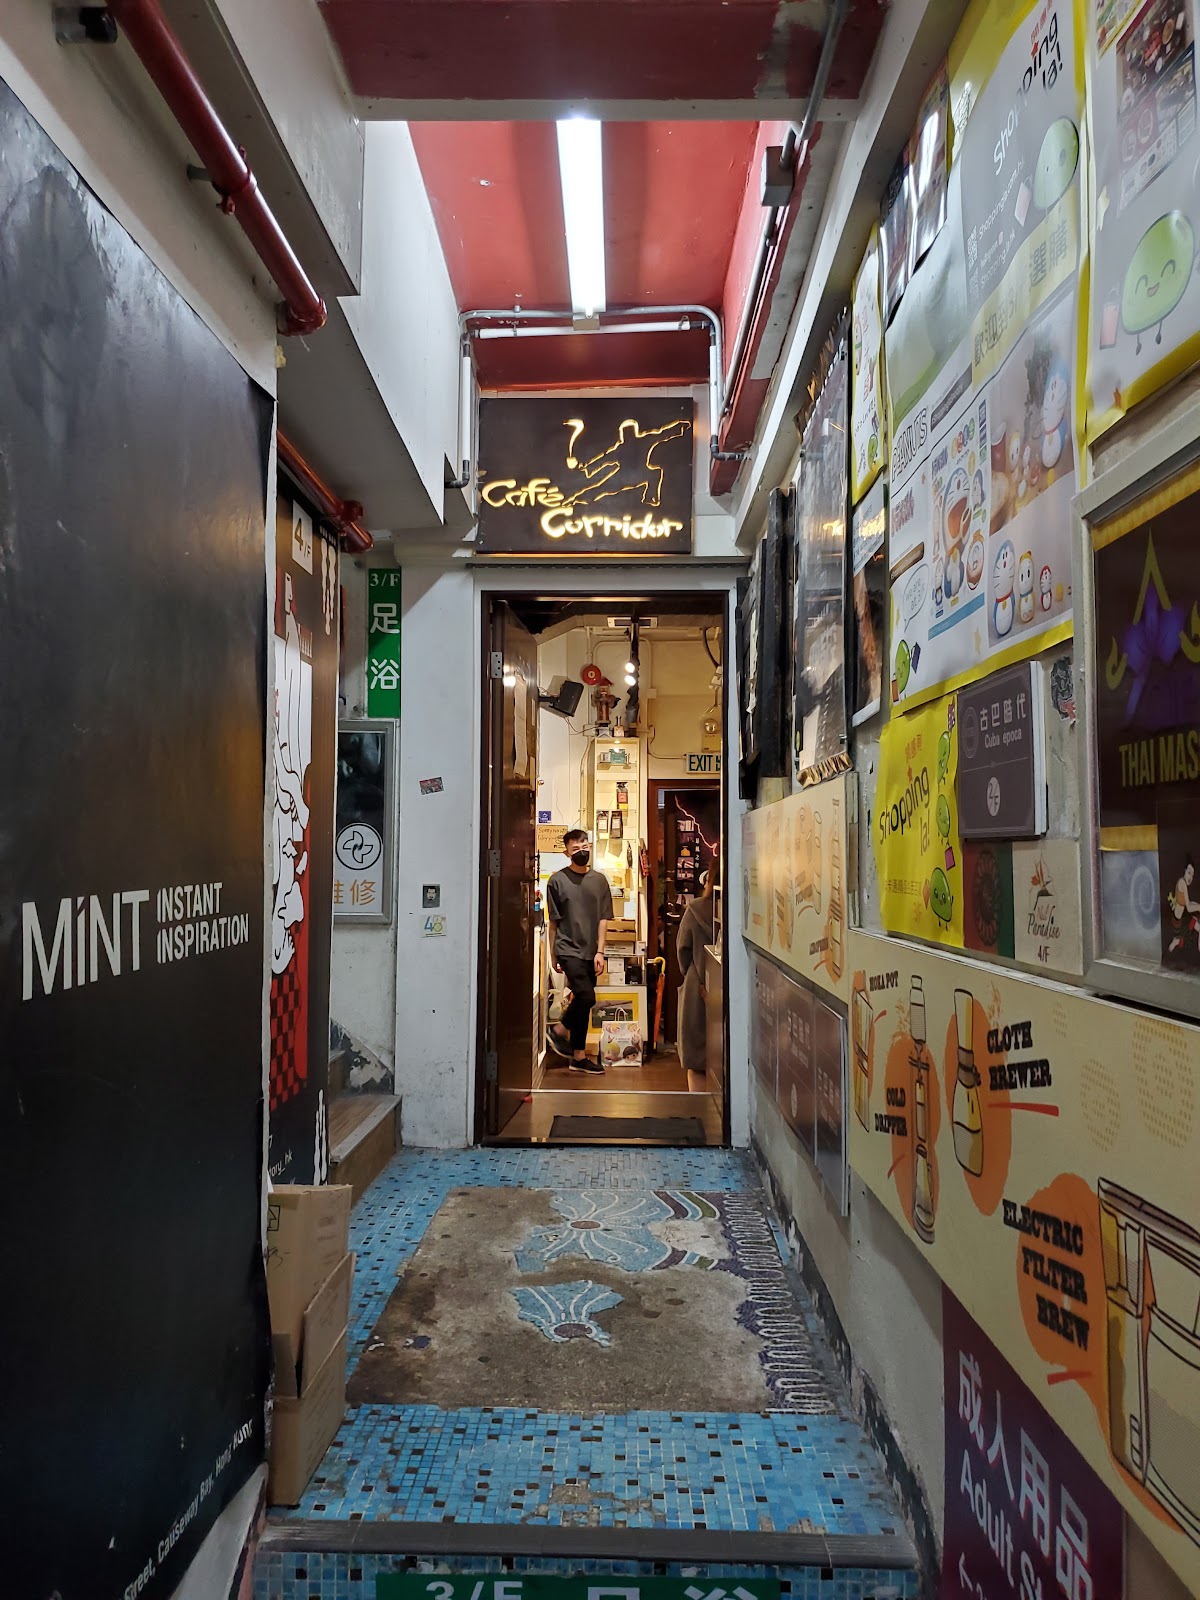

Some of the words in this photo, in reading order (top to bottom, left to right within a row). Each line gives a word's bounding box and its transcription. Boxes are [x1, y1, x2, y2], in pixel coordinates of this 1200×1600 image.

[892, 408, 928, 483] PEANUTS
[541, 507, 683, 539] Corridor
[369, 573, 400, 587] 3/F
[369, 602, 400, 690] 足浴
[688, 754, 713, 772] EXIT
[984, 732, 1000, 748] Cuba
[1119, 739, 1155, 787] THAI
[1160, 730, 1200, 783] MAS
[880, 767, 930, 845] Shopping
[157, 882, 222, 923] INSTANT
[157, 913, 249, 964] INSPIRATION
[886, 970, 899, 989] POT
[987, 1021, 1033, 1053] CLOTH
[886, 1087, 906, 1108] COLD
[989, 1058, 1052, 1091] BREWER
[874, 1112, 908, 1138] DRIPPER
[1002, 1199, 1084, 1257] ELECTRIC
[1022, 1246, 1088, 1306] FILTER
[1036, 1294, 1090, 1352] BREW
[959, 1350, 1093, 1600] 成人用品
[157, 1493, 200, 1563] Causeway
[216, 1442, 232, 1477] Hong
[960, 1449, 1015, 1588] Adult
